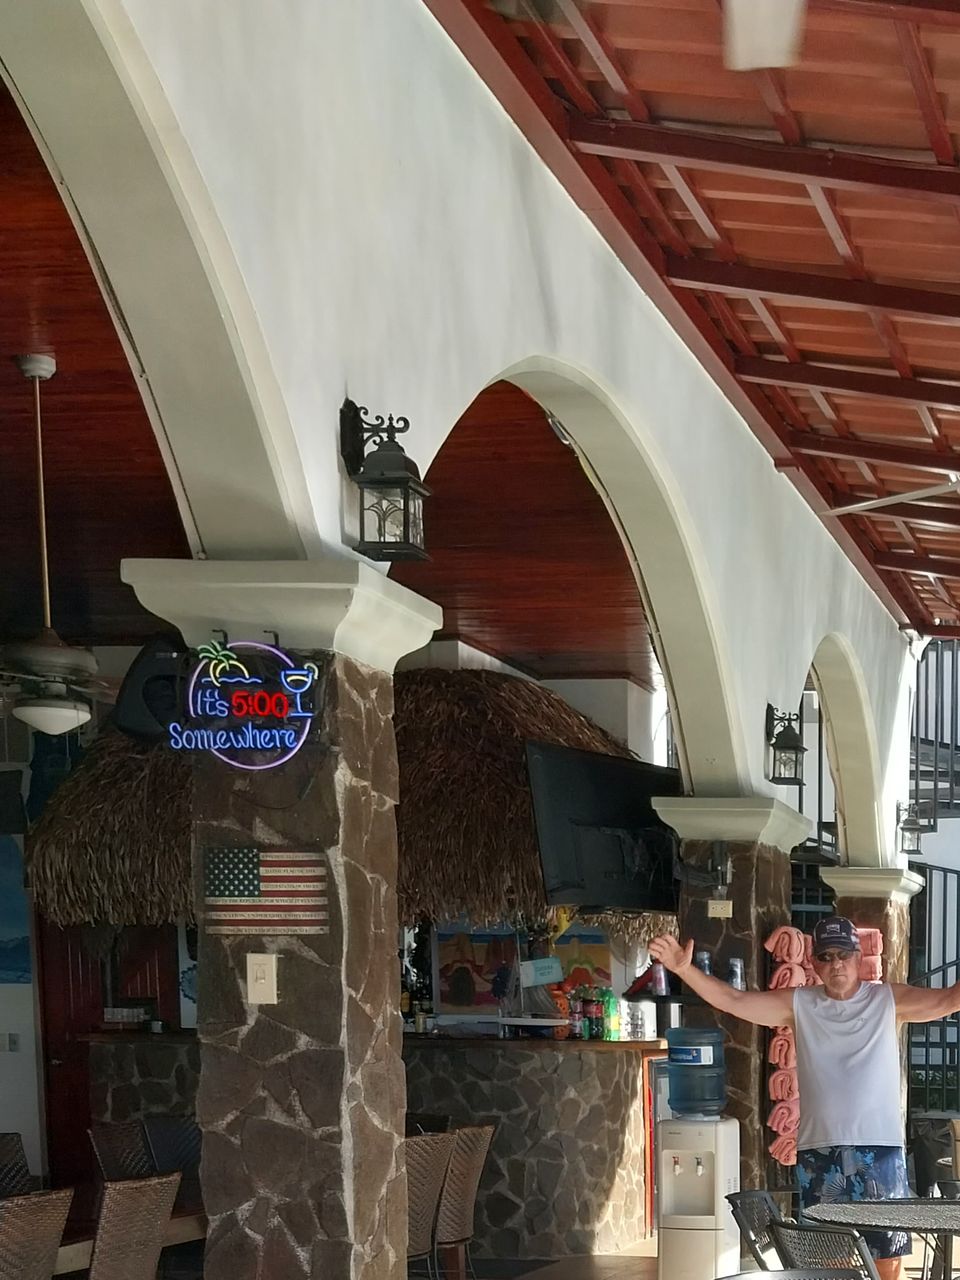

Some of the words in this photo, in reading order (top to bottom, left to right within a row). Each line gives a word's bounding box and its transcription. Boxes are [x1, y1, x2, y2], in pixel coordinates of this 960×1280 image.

[197, 689, 229, 717] It's
[231, 689, 289, 718] 5:00
[169, 721, 298, 750] Somewhere
